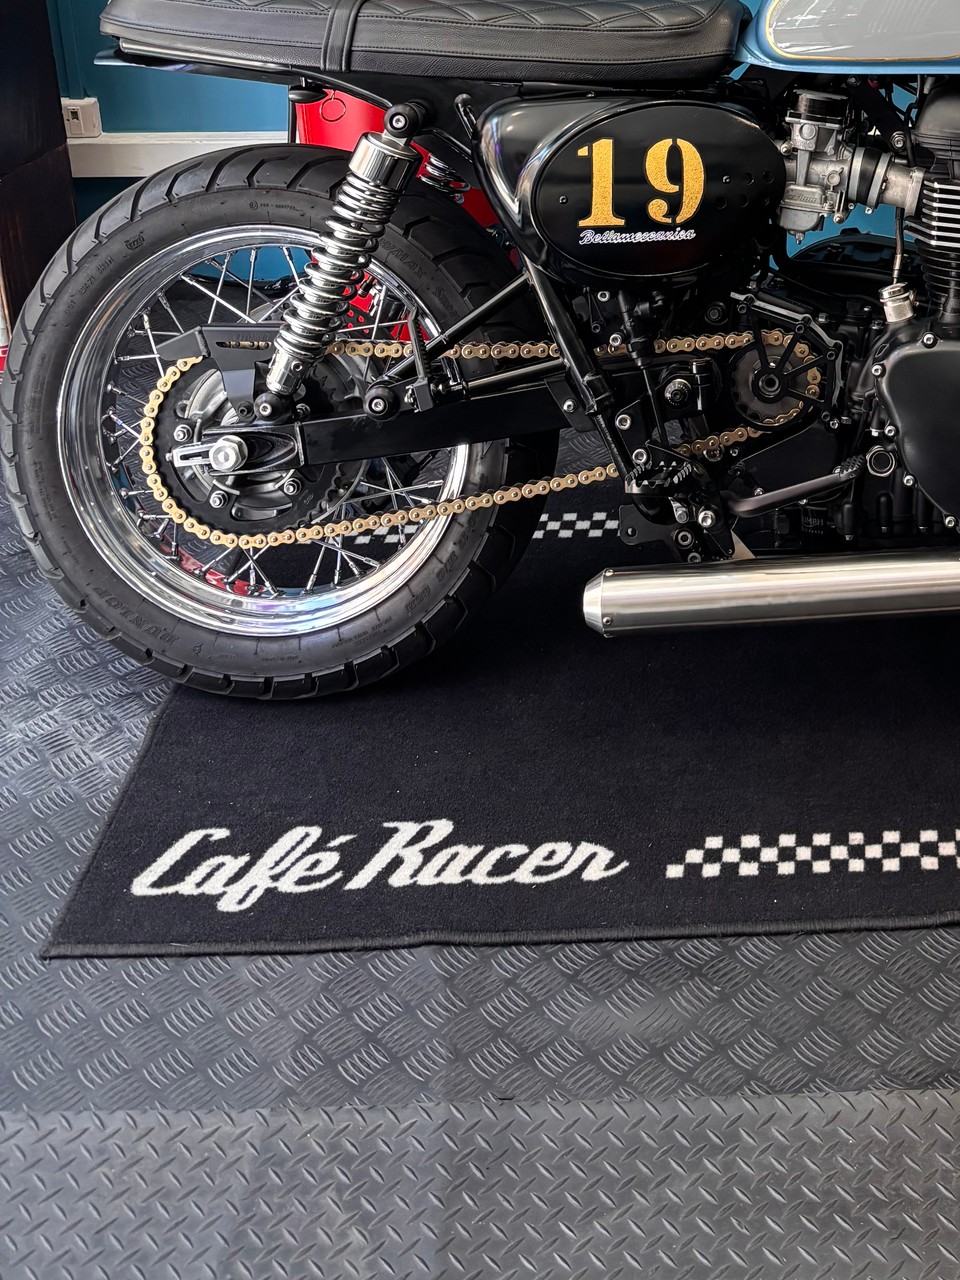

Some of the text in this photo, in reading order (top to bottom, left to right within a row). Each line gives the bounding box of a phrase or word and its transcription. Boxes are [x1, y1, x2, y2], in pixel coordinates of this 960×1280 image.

[577, 137, 705, 227] 19
[130, 818, 629, 913] Café Racer
